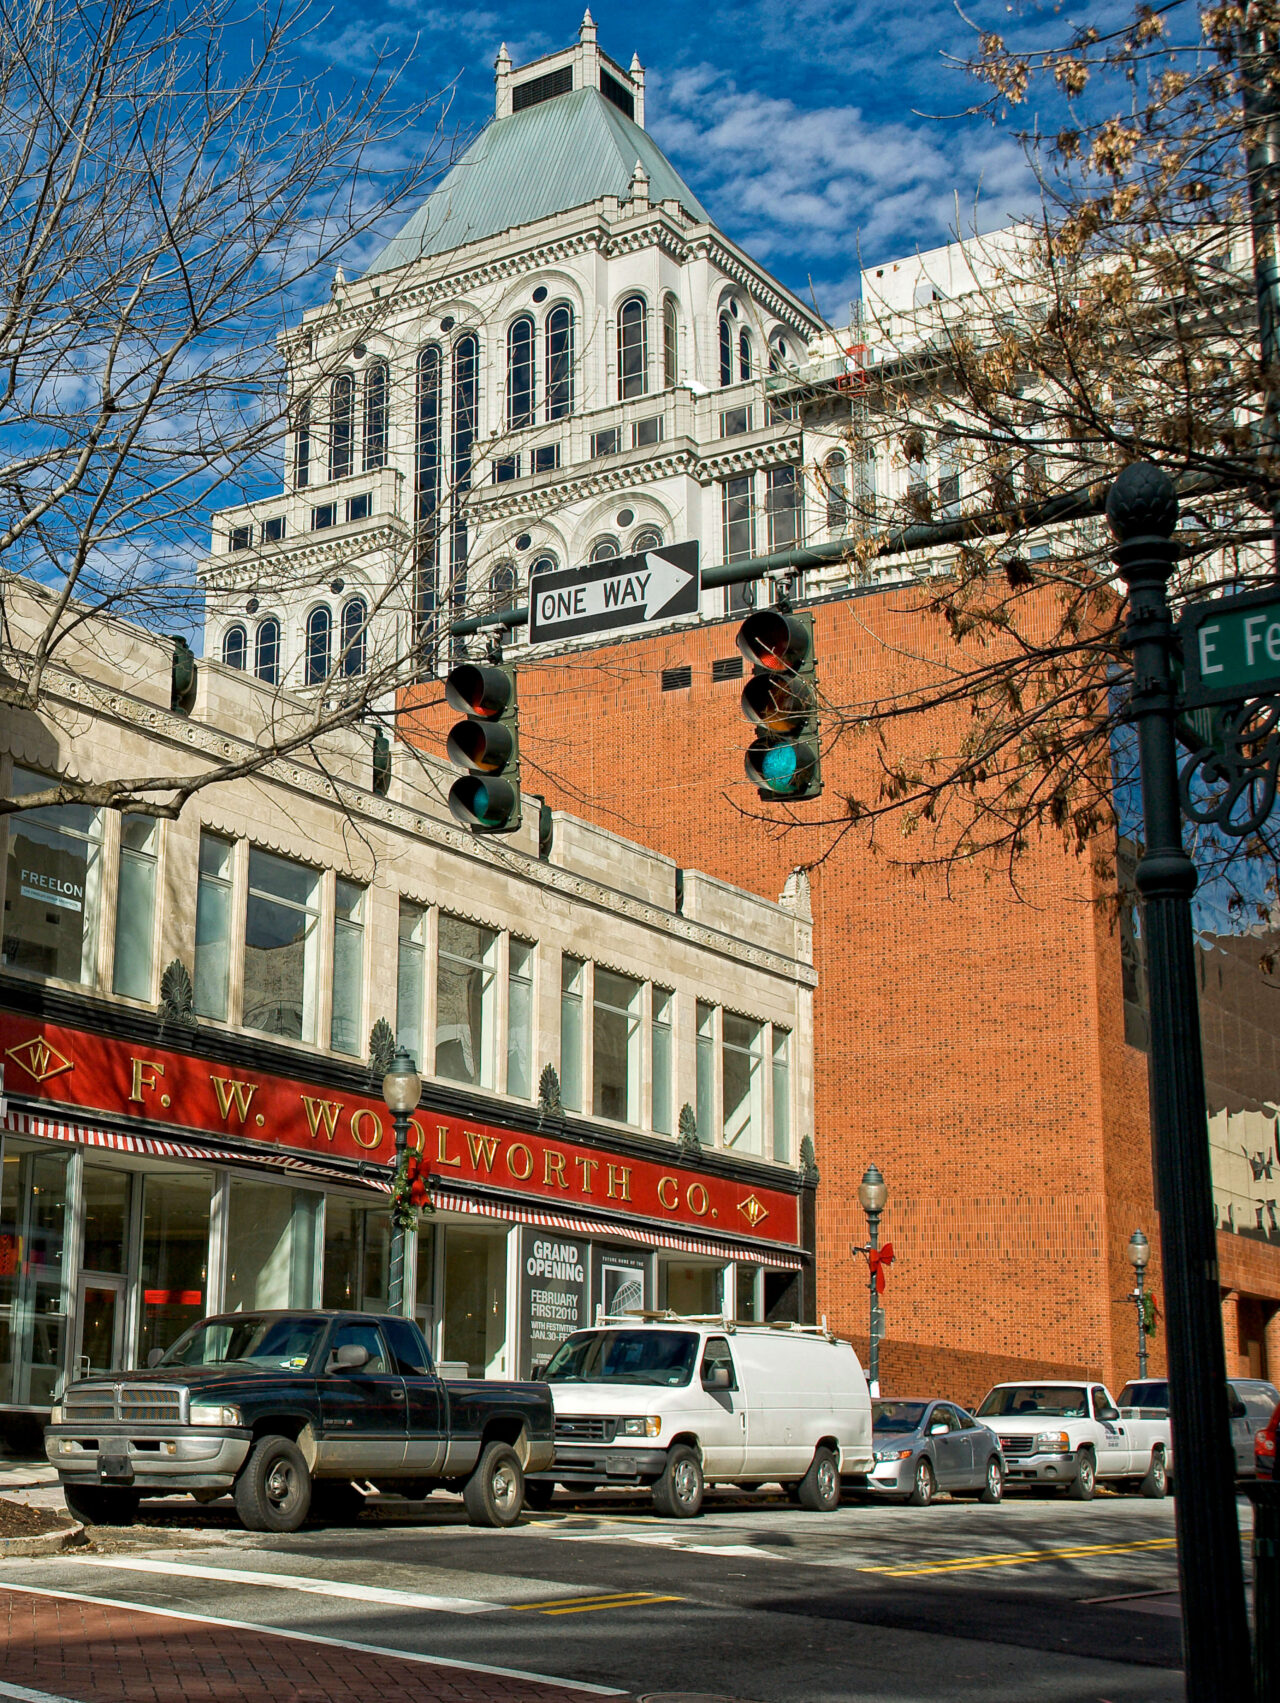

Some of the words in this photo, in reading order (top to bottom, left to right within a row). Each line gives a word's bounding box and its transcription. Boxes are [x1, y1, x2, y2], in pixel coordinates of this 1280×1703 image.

[542, 588, 587, 620] ONE
[603, 573, 652, 608] WAY
[1198, 625, 1224, 675] E
[21, 869, 83, 898] FREELON
[28, 1043, 51, 1075] W
[128, 1057, 173, 1109] F.
[210, 1075, 265, 1128] W.
[657, 1176, 719, 1219] CO.
[533, 1240, 579, 1264] GRAND
[526, 1257, 585, 1283] OPENING
[531, 1289, 579, 1308] FEBRUARY
[531, 1303, 578, 1321] FIRST2010
[531, 1320, 546, 1330] WITH
